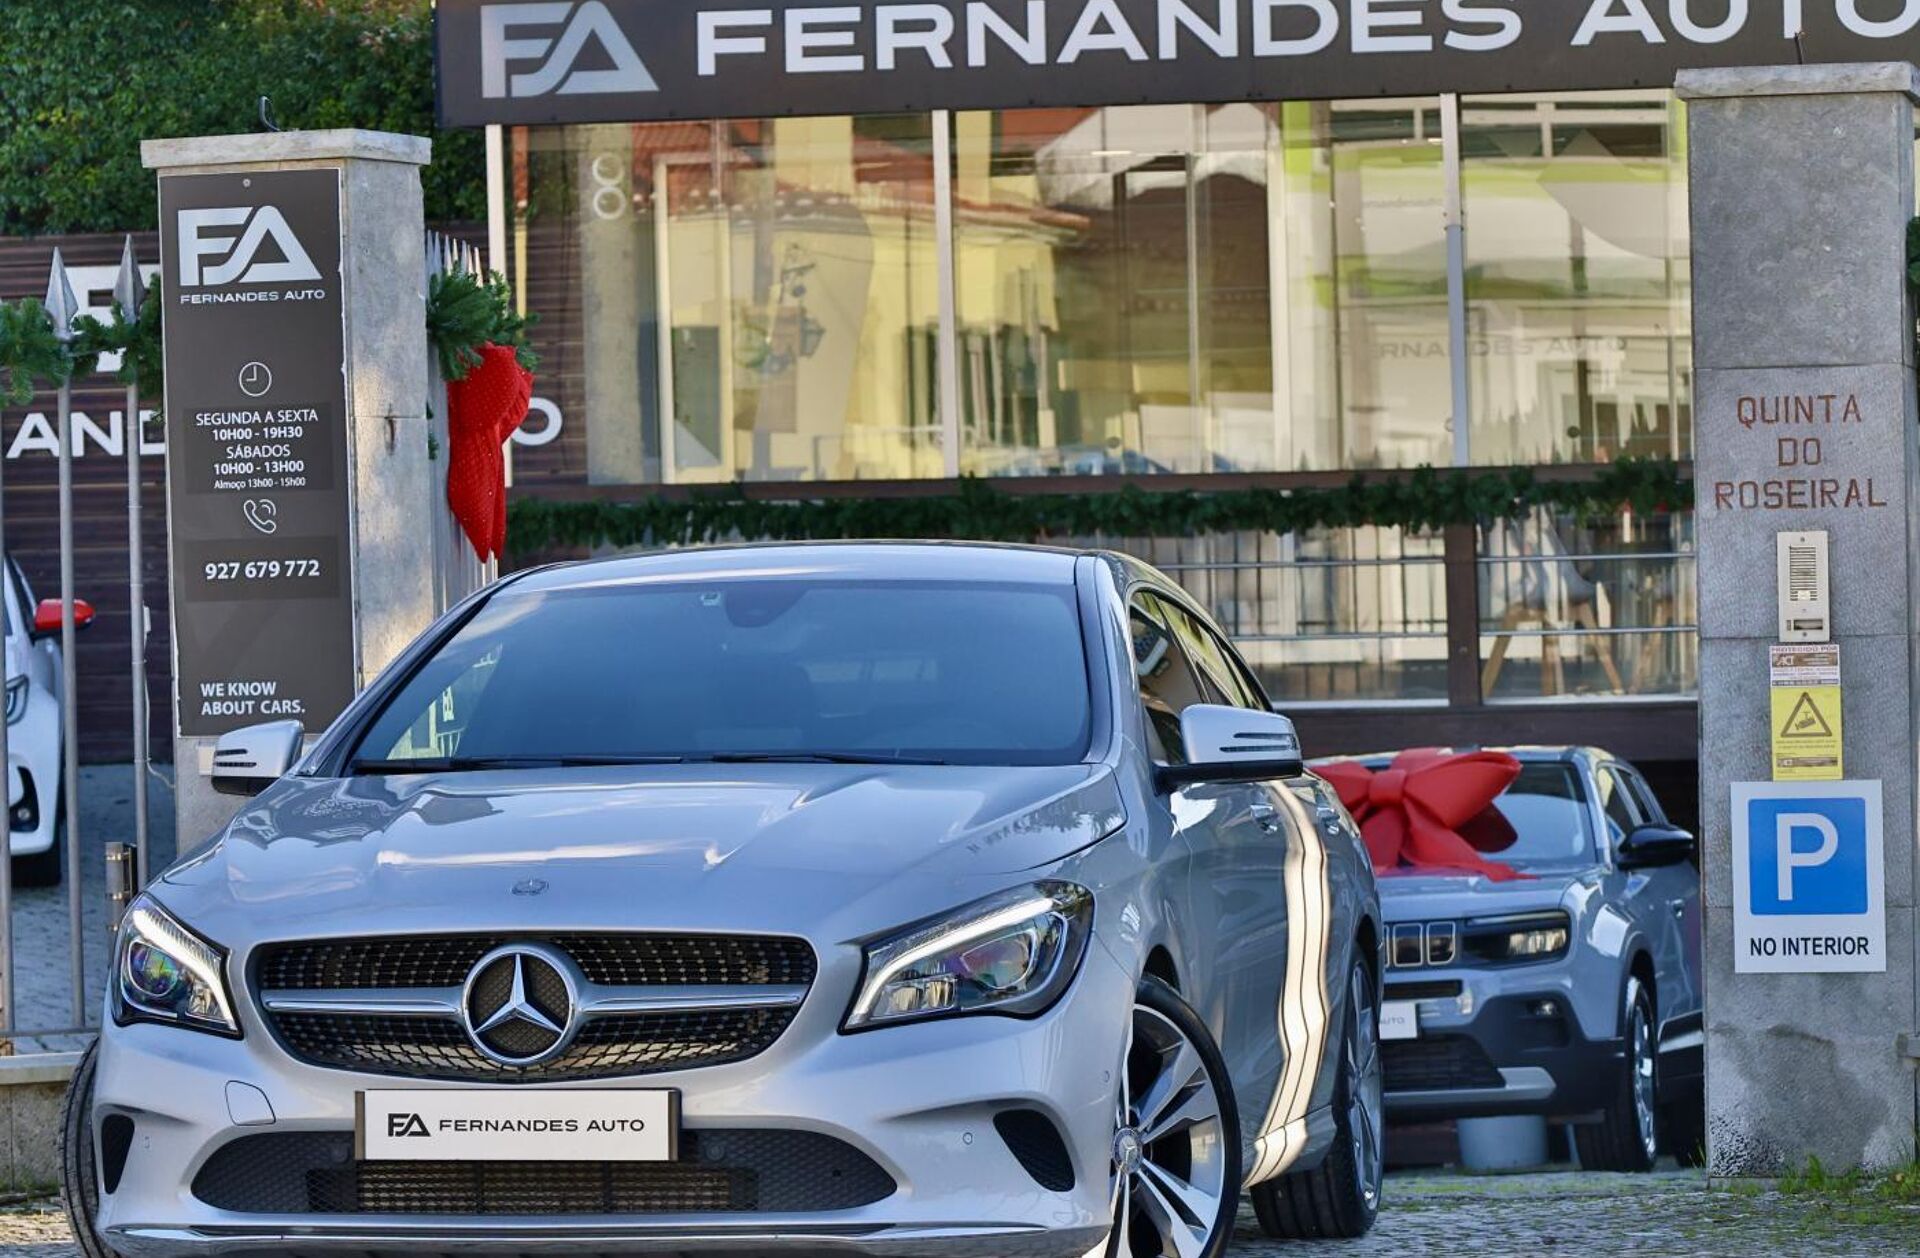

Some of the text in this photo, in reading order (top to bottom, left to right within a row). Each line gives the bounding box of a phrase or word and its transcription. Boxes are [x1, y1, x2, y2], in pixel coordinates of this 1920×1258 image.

[481, 0, 660, 98] FA
[697, 0, 1522, 76] FERNANDES
[178, 205, 323, 286] FA
[180, 289, 325, 304] FERNANDES AUTO
[196, 409, 318, 426] SEGUNDA A SEXTA
[1737, 394, 1862, 429] QUINTA
[212, 428, 252, 441] 10H00
[263, 426, 302, 438] 19H30
[226, 444, 291, 459] SÁBADOS
[1777, 437, 1822, 466] DO
[214, 462, 254, 475] 10H00
[264, 460, 304, 472] 13H00
[214, 479, 246, 490] Almoço
[248, 478, 273, 488] 13h00
[281, 477, 306, 487] 15h00
[1714, 478, 1887, 510] ROSEIRAL
[205, 559, 320, 580] 927 679 772
[200, 681, 277, 697] WE KNOW
[201, 699, 306, 715] ABOUT CARS.
[1776, 812, 1839, 901] P
[1750, 936, 1870, 956] NO INTERIOR
[387, 1112, 645, 1137] FA FERNANDES AUTO
